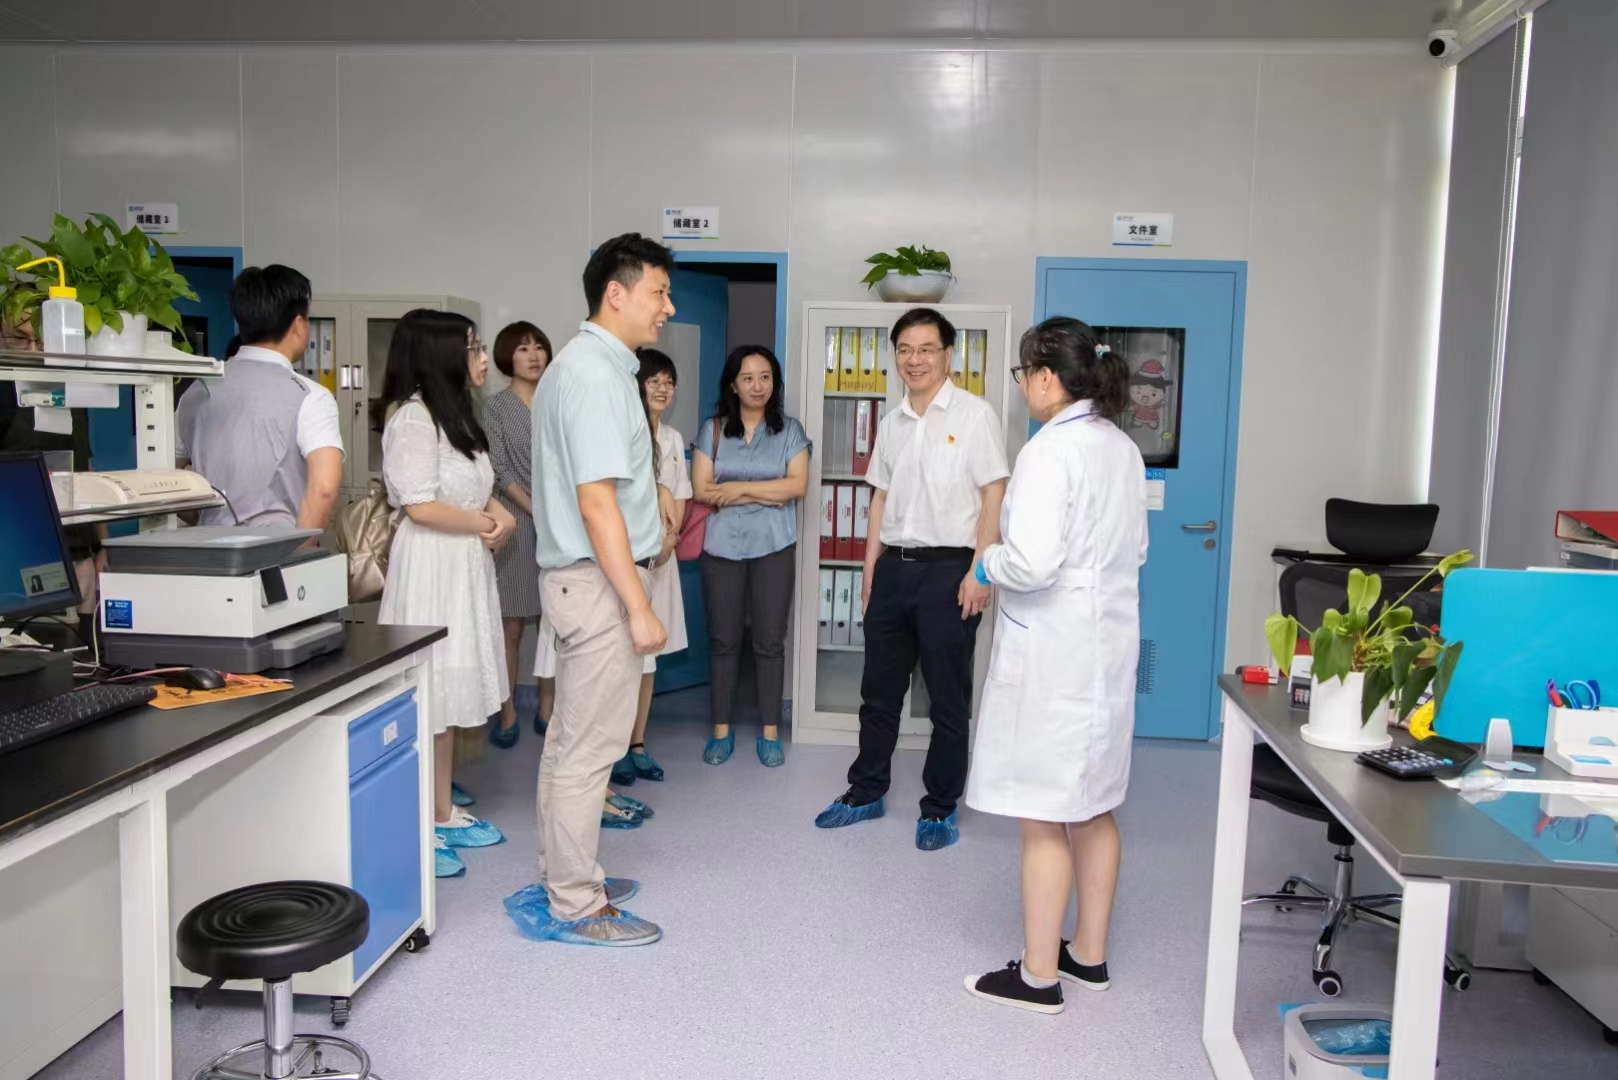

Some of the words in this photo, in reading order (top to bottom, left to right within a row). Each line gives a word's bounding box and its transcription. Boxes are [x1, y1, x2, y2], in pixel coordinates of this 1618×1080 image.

[164, 215, 169, 224] 1
[673, 218, 701, 228] 储藏室
[703, 219, 709, 228] 2
[1128, 224, 1159, 236] 文件室
